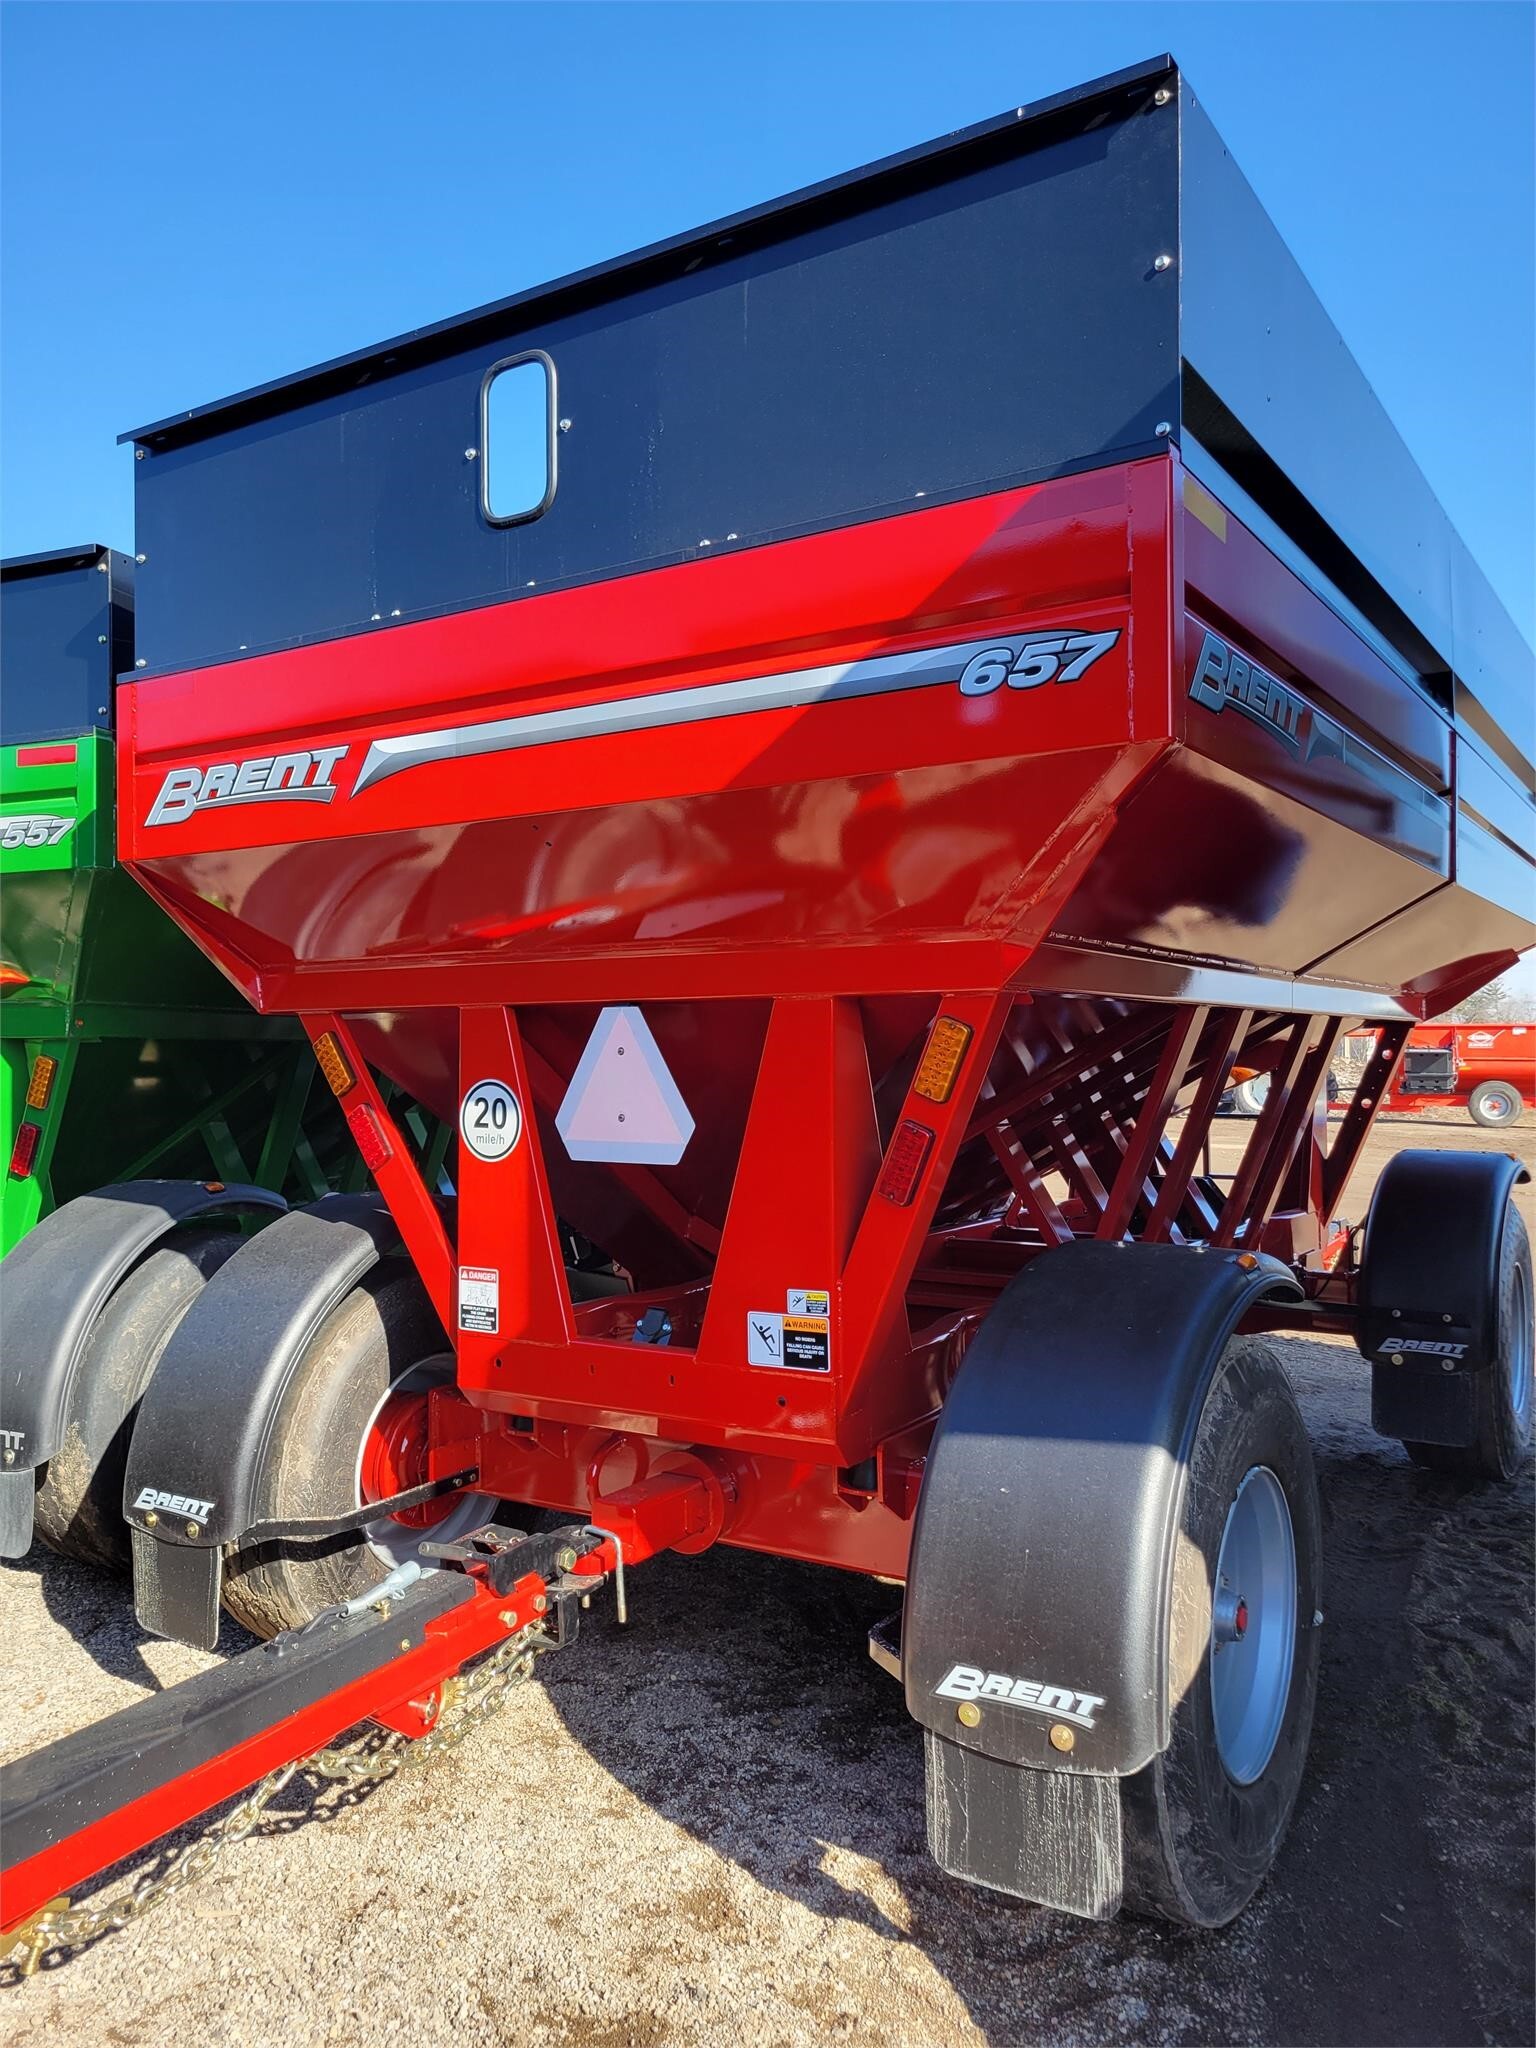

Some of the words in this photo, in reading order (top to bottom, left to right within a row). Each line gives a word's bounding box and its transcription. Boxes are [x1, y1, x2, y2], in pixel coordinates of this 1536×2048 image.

[960, 628, 1122, 696] 657
[1189, 632, 1305, 741] BRENT
[144, 745, 349, 827] BRENT
[1, 817, 77, 849] 557
[473, 1096, 507, 1130] 20
[476, 1133, 505, 1145] mile/h
[468, 1271, 496, 1281] DANGER
[791, 1320, 827, 1331] WARNING
[1376, 1337, 1469, 1356] BRENT
[133, 1487, 215, 1520] BRENT
[935, 1665, 1105, 1722] BRENT
